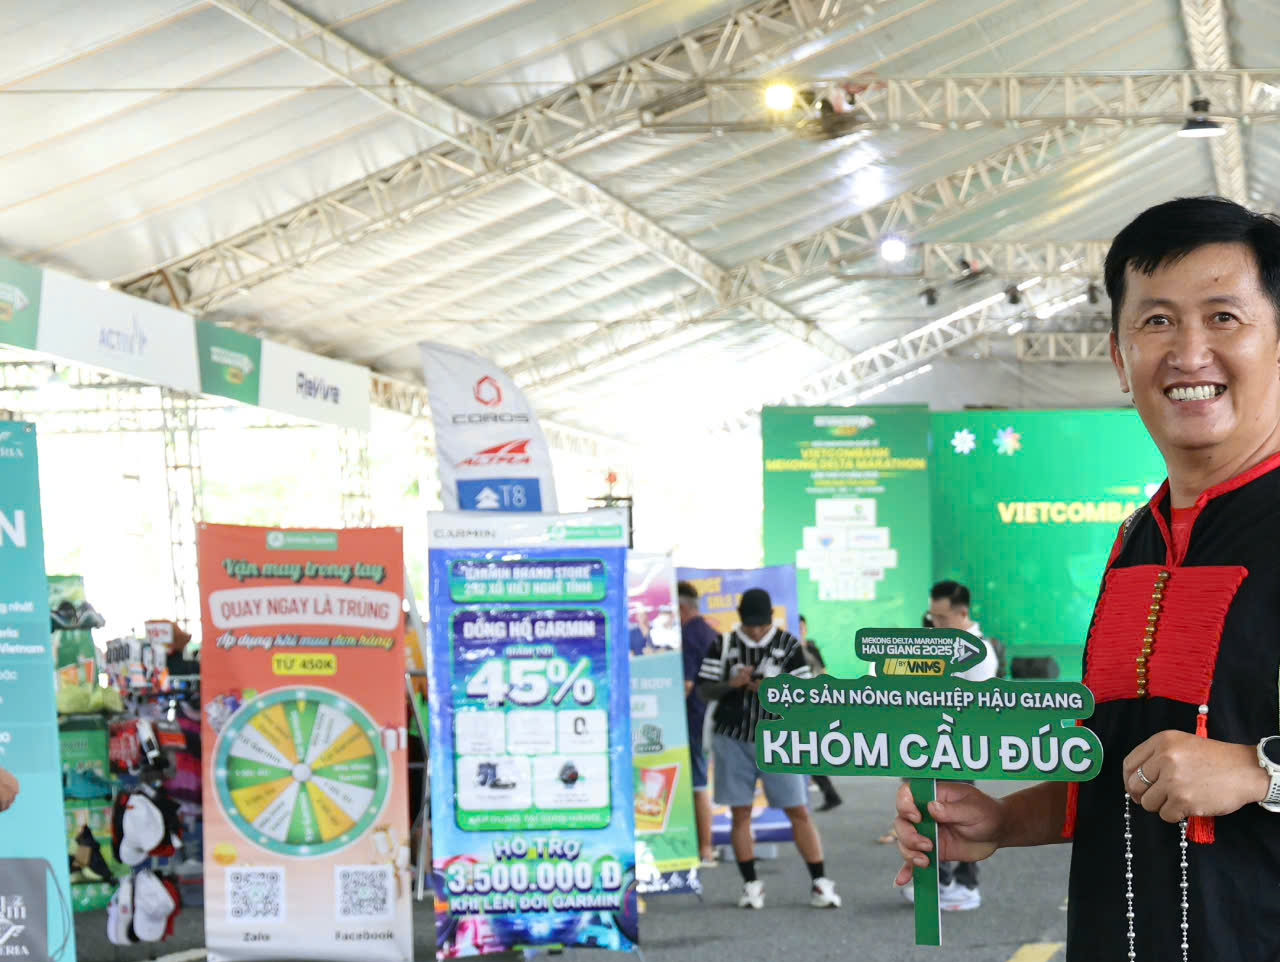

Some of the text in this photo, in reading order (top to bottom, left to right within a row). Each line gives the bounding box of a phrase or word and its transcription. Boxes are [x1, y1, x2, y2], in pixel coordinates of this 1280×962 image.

[499, 485, 526, 507] T8
[998, 501, 1147, 523] VIETCOMBA
[222, 557, 260, 582] Vận
[221, 594, 390, 621] QUAY NGAY LÀ TRÚNG
[534, 620, 597, 638] GARMIN
[862, 637, 953, 646] MEKONG DELTA MARATHON
[862, 645, 953, 656] HAU GIANG 2025
[908, 660, 941, 673] VNMS
[464, 656, 596, 706] 45%
[767, 684, 1083, 712] ĐẶC SẢN NÔNG NGHIỆP HẬU GIANG
[763, 712, 1093, 772] KHÓM CẦU ĐÚC
[447, 860, 593, 893] 3.500.000
[551, 894, 620, 911] GARMIN
[335, 929, 395, 942] Facebook
